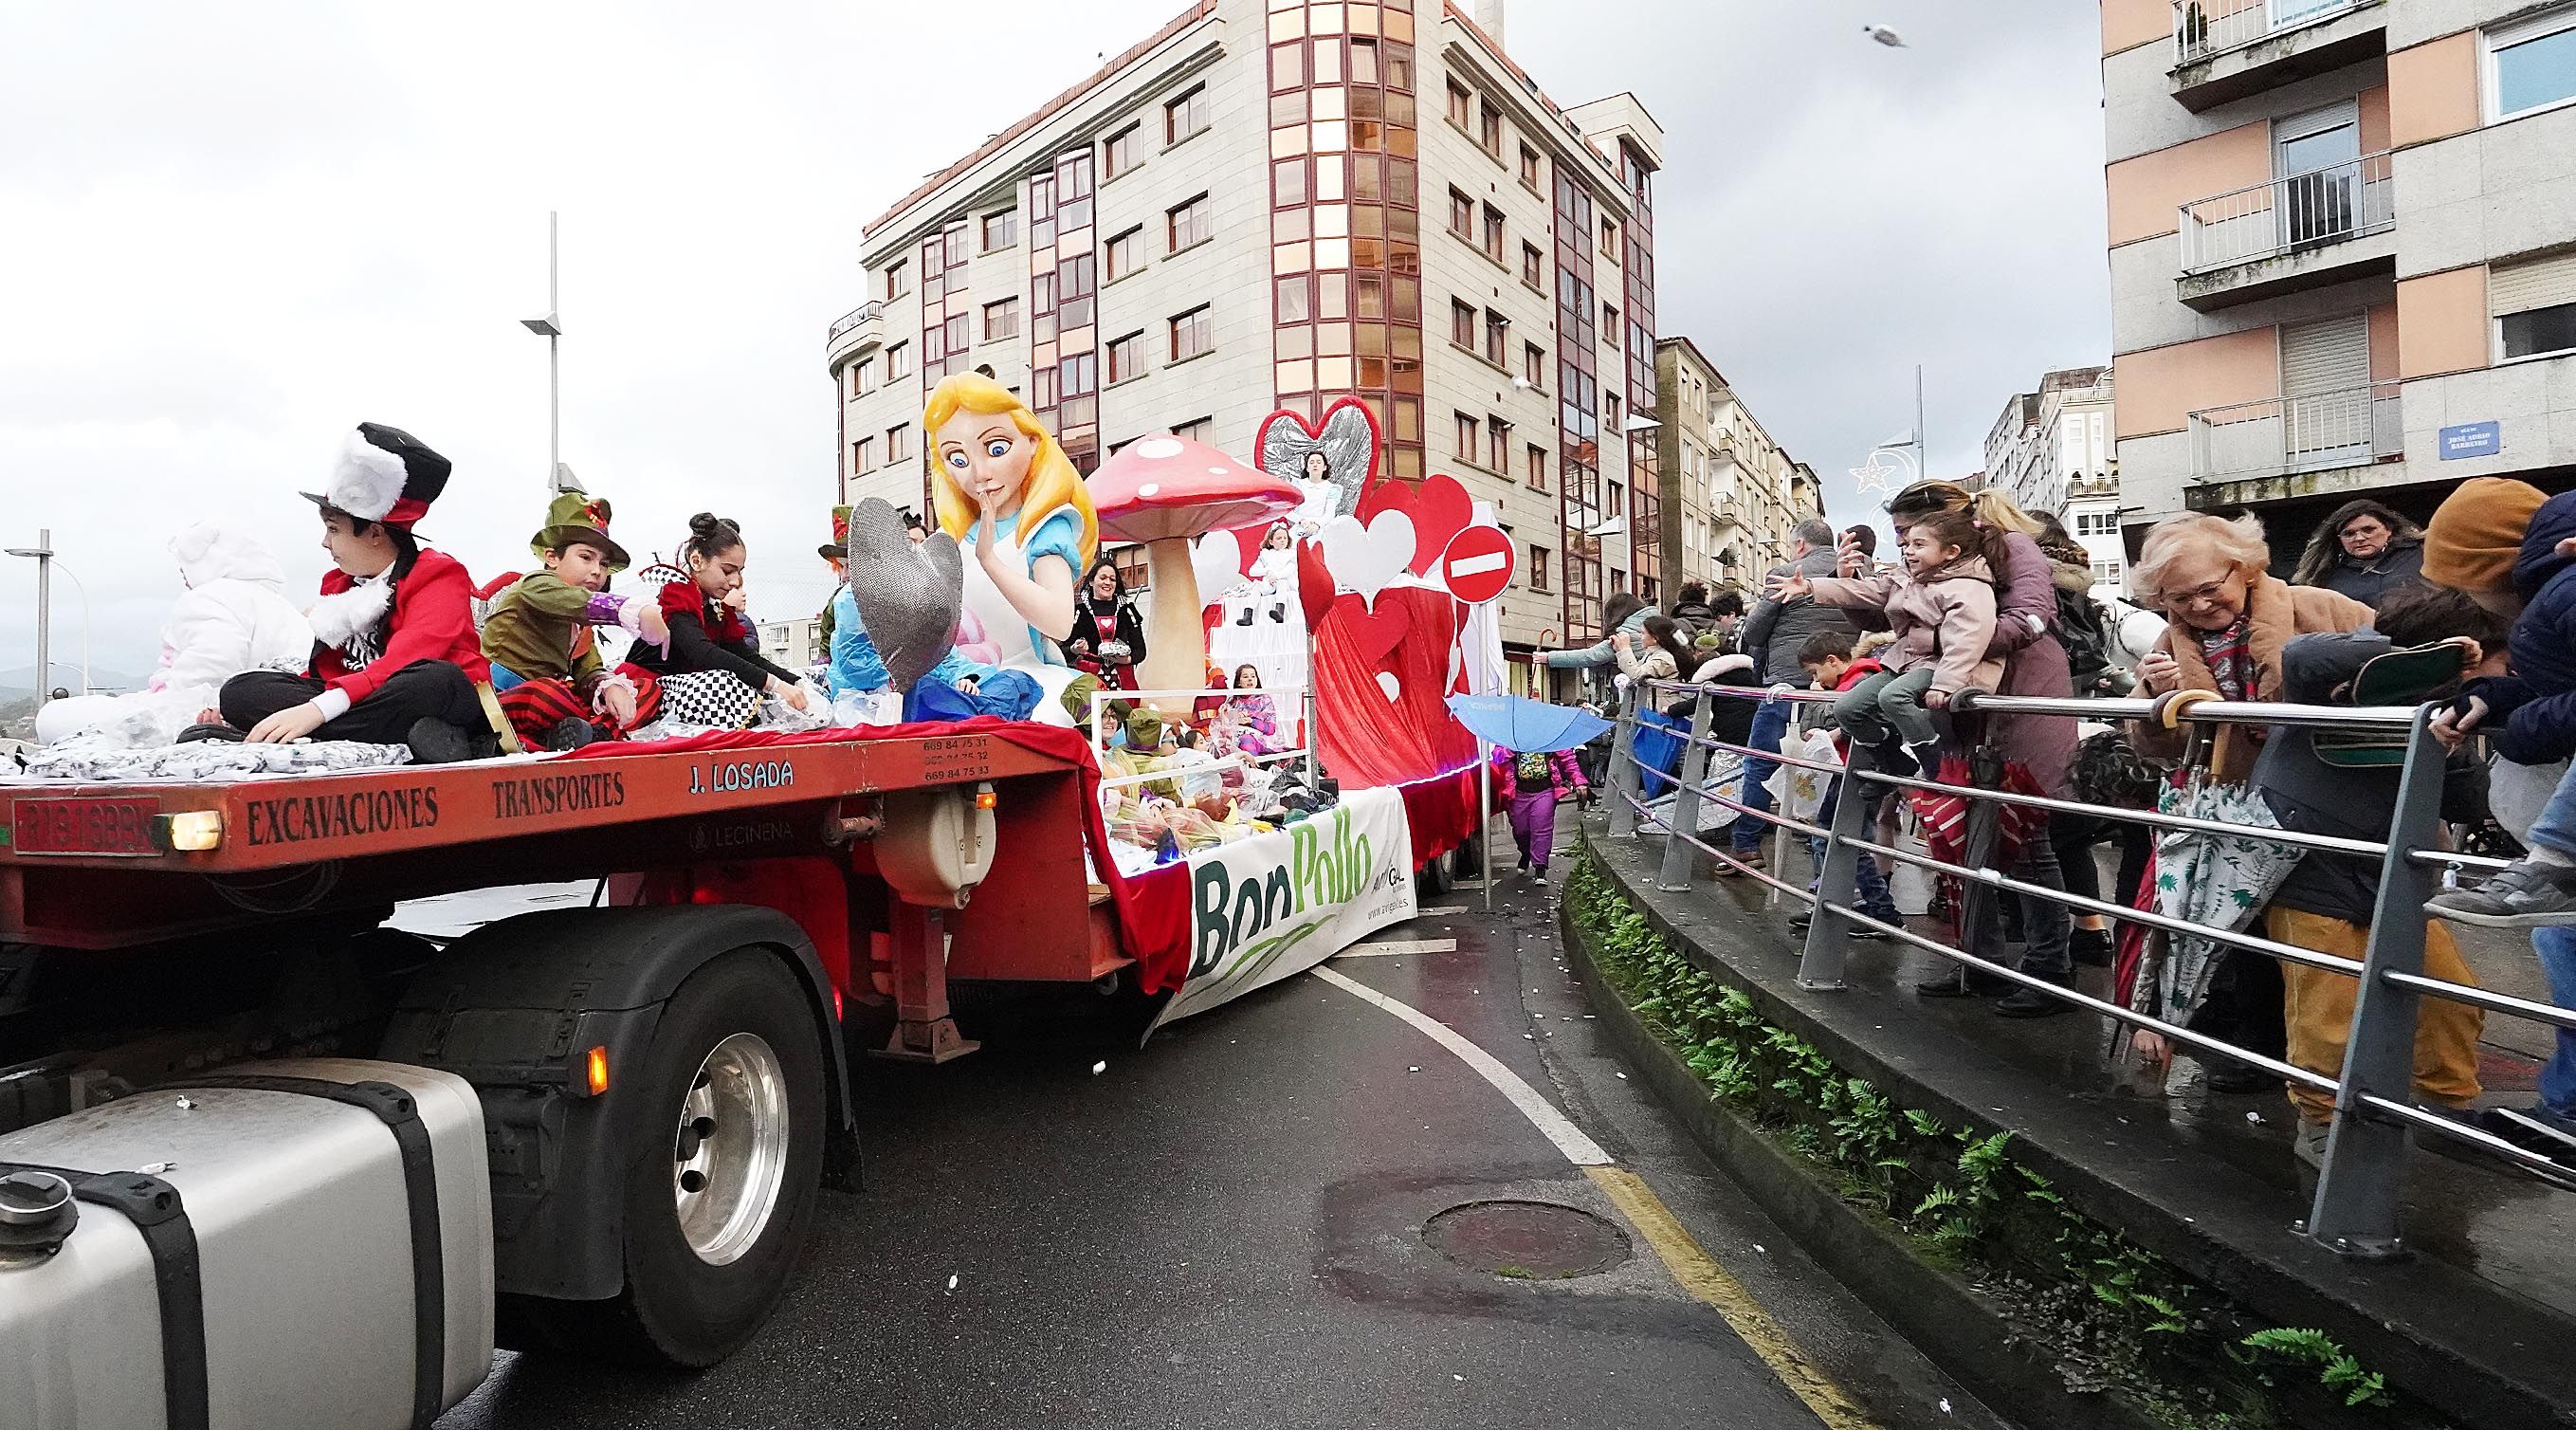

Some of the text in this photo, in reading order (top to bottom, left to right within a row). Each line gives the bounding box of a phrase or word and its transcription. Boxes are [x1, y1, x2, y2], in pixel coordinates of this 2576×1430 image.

[925, 771, 944, 781] 669
[948, 769, 959, 778] 84
[963, 767, 975, 776] 75
[247, 760, 794, 846] EXCAVACIONES TRANSPORTES J. LOSADA
